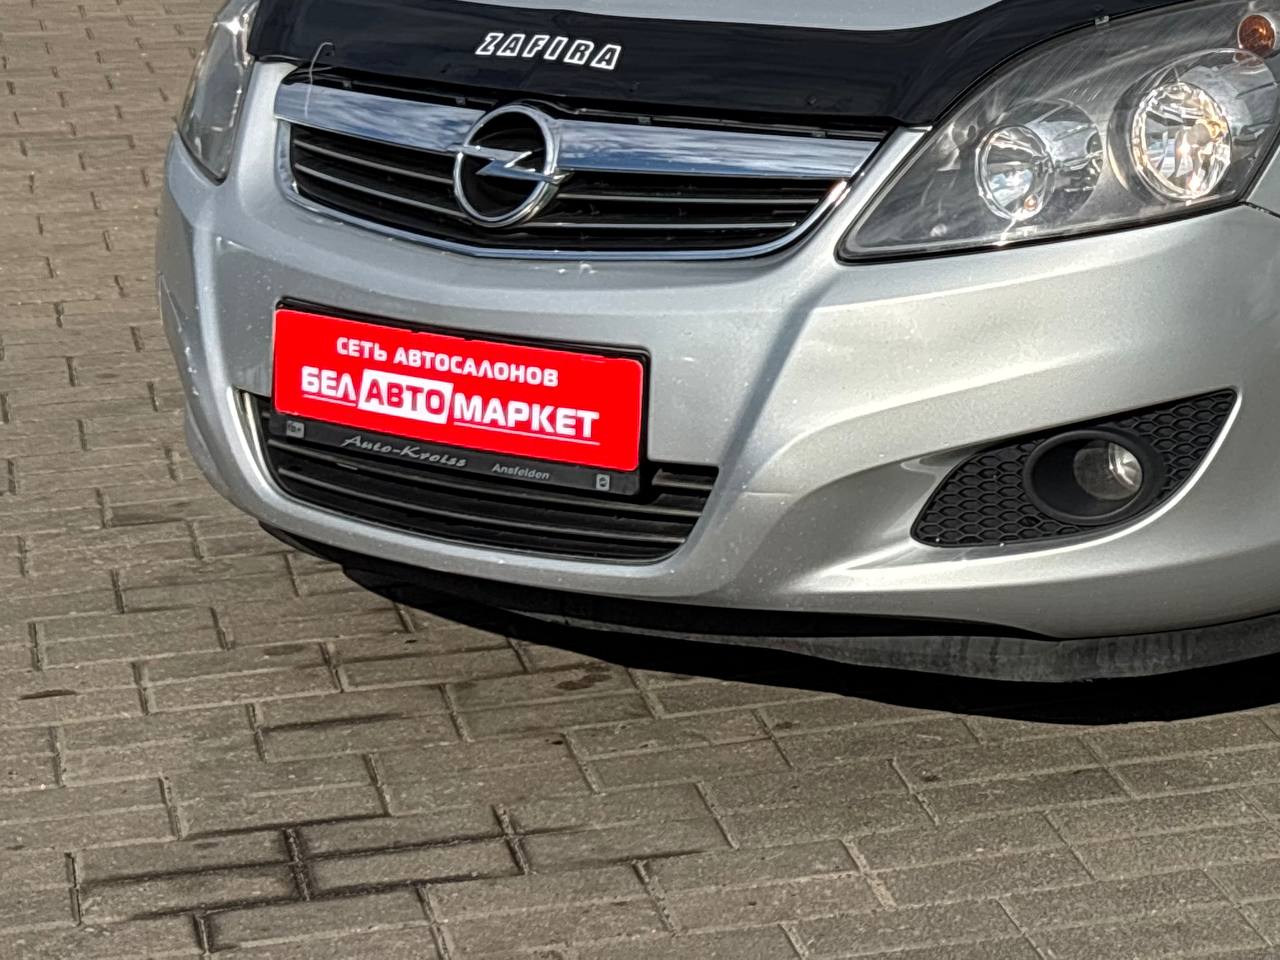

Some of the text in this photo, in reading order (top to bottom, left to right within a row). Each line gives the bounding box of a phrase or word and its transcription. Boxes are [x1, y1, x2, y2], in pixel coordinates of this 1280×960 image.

[475, 32, 622, 70] ZAFIRA
[336, 337, 559, 387] СЕТЬ АВТОСАЛОНОВ
[491, 463, 550, 481] Ansfelden
